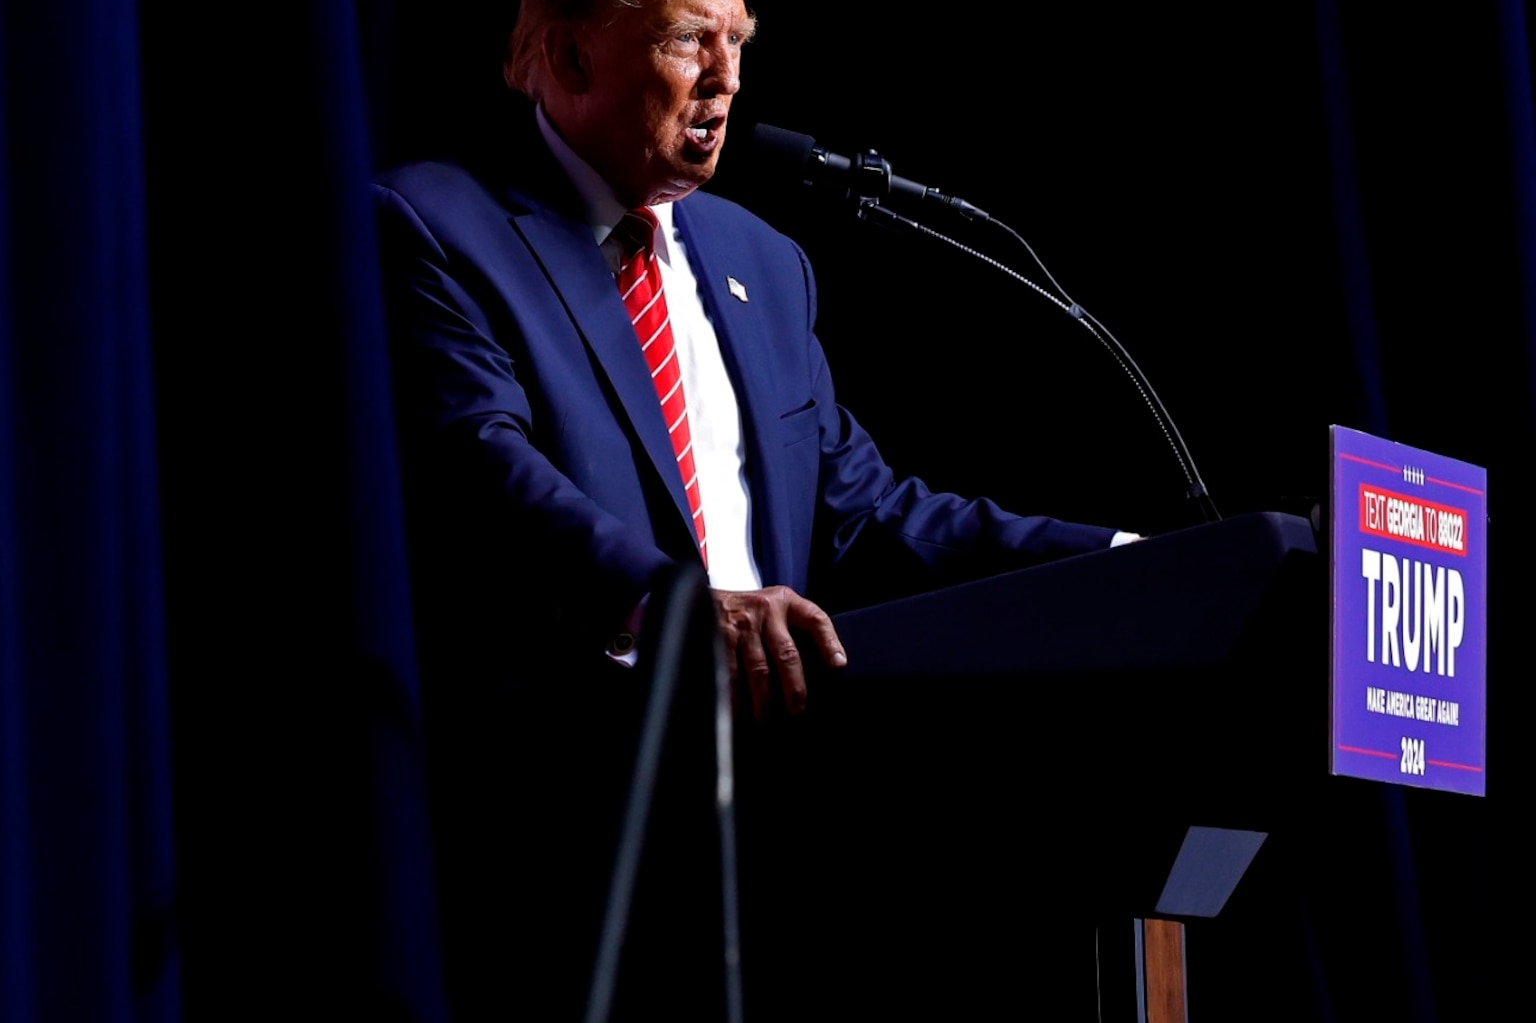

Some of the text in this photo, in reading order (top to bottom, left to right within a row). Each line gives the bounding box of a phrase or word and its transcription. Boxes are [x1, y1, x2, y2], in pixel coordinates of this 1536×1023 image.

[1364, 491, 1463, 551] TEXT GEORGIA TO 88022
[1362, 548, 1464, 678] TRUMP
[1367, 686, 1459, 726] MAKE AMERICA GREAT AGAIN!
[1400, 736, 1425, 776] 2024
